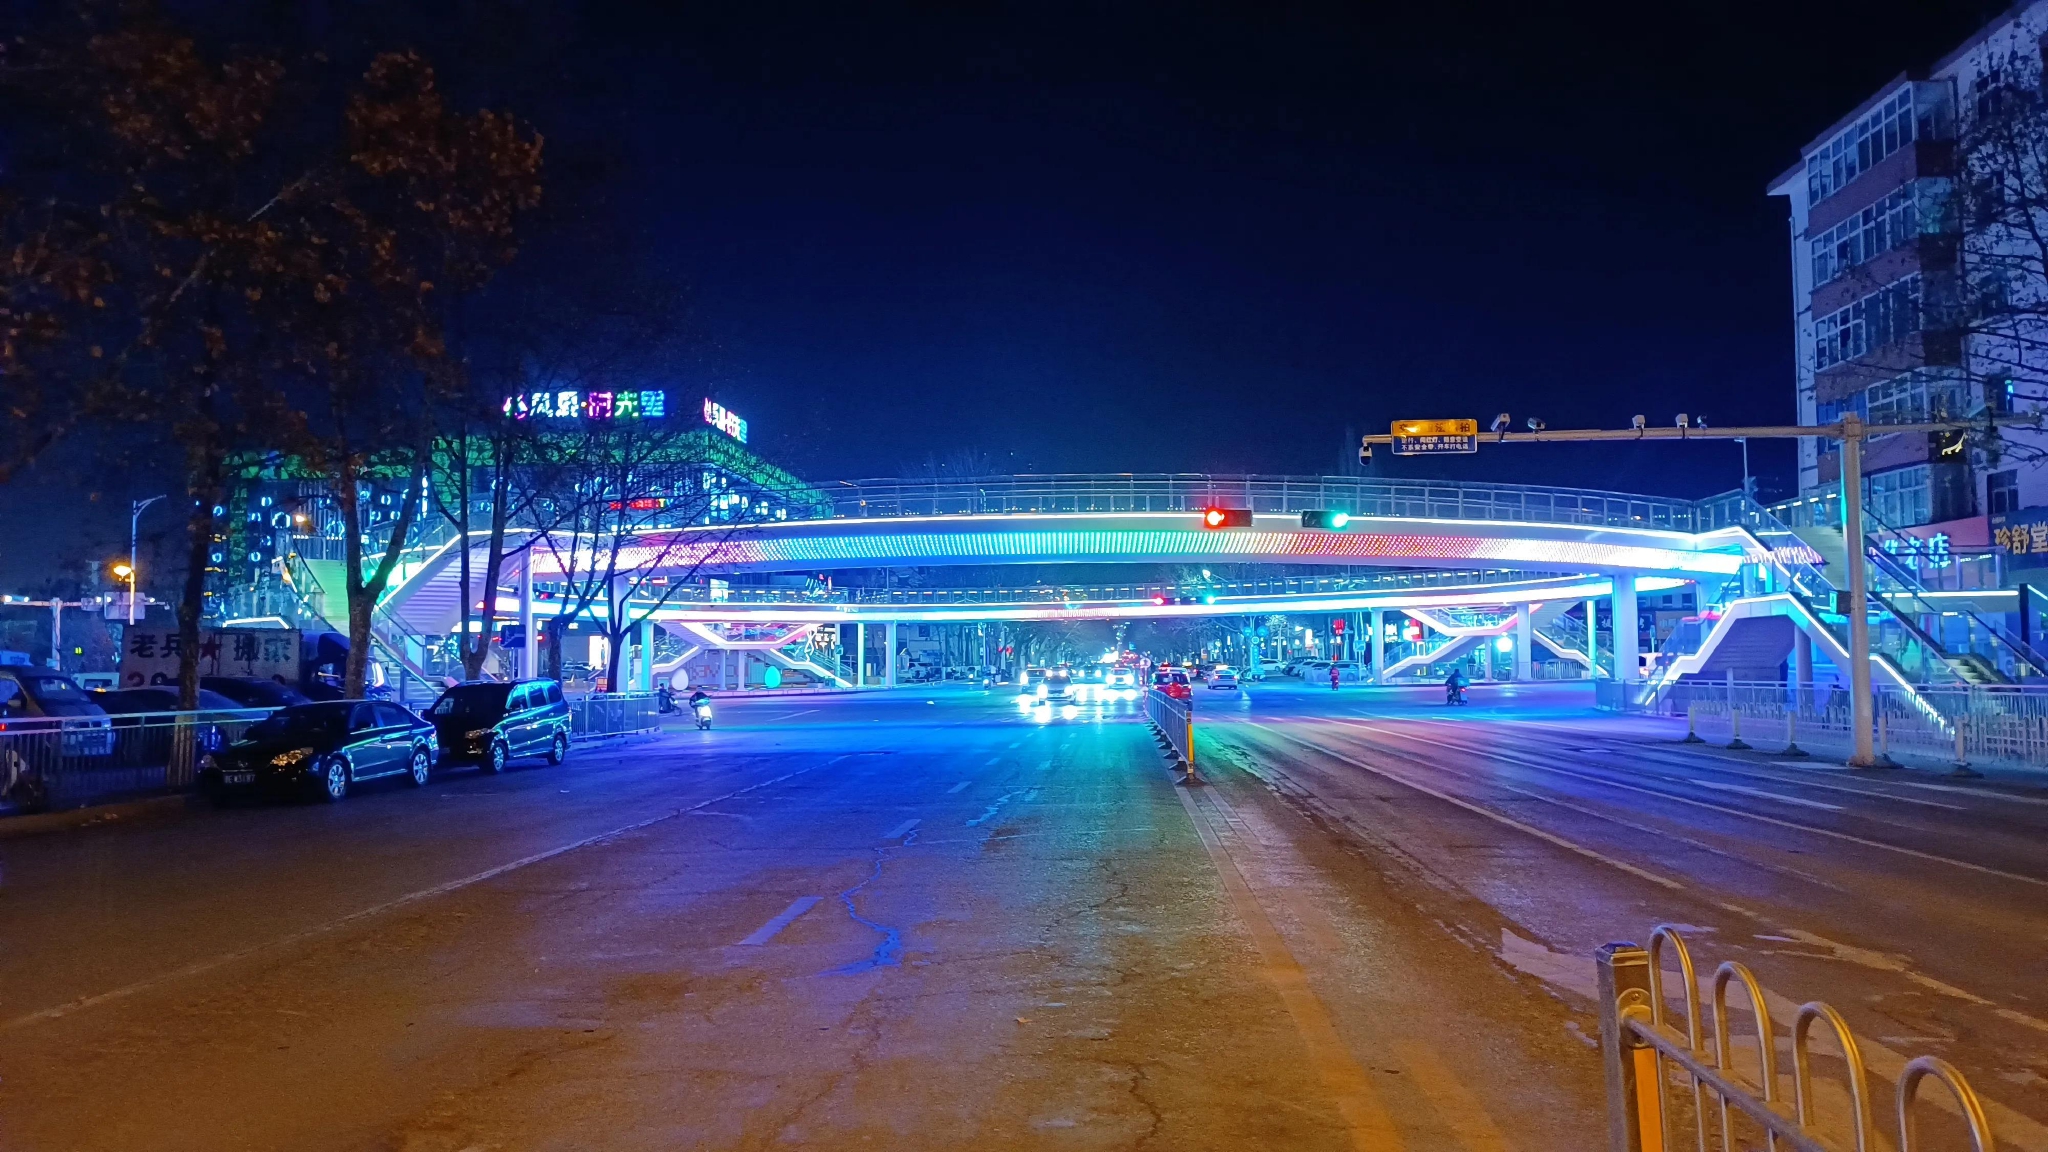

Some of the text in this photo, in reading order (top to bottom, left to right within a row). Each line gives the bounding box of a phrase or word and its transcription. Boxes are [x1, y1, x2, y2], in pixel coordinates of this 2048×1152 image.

[1993, 521, 2048, 555] 珍舒堂
[130, 633, 182, 658] 老兵
